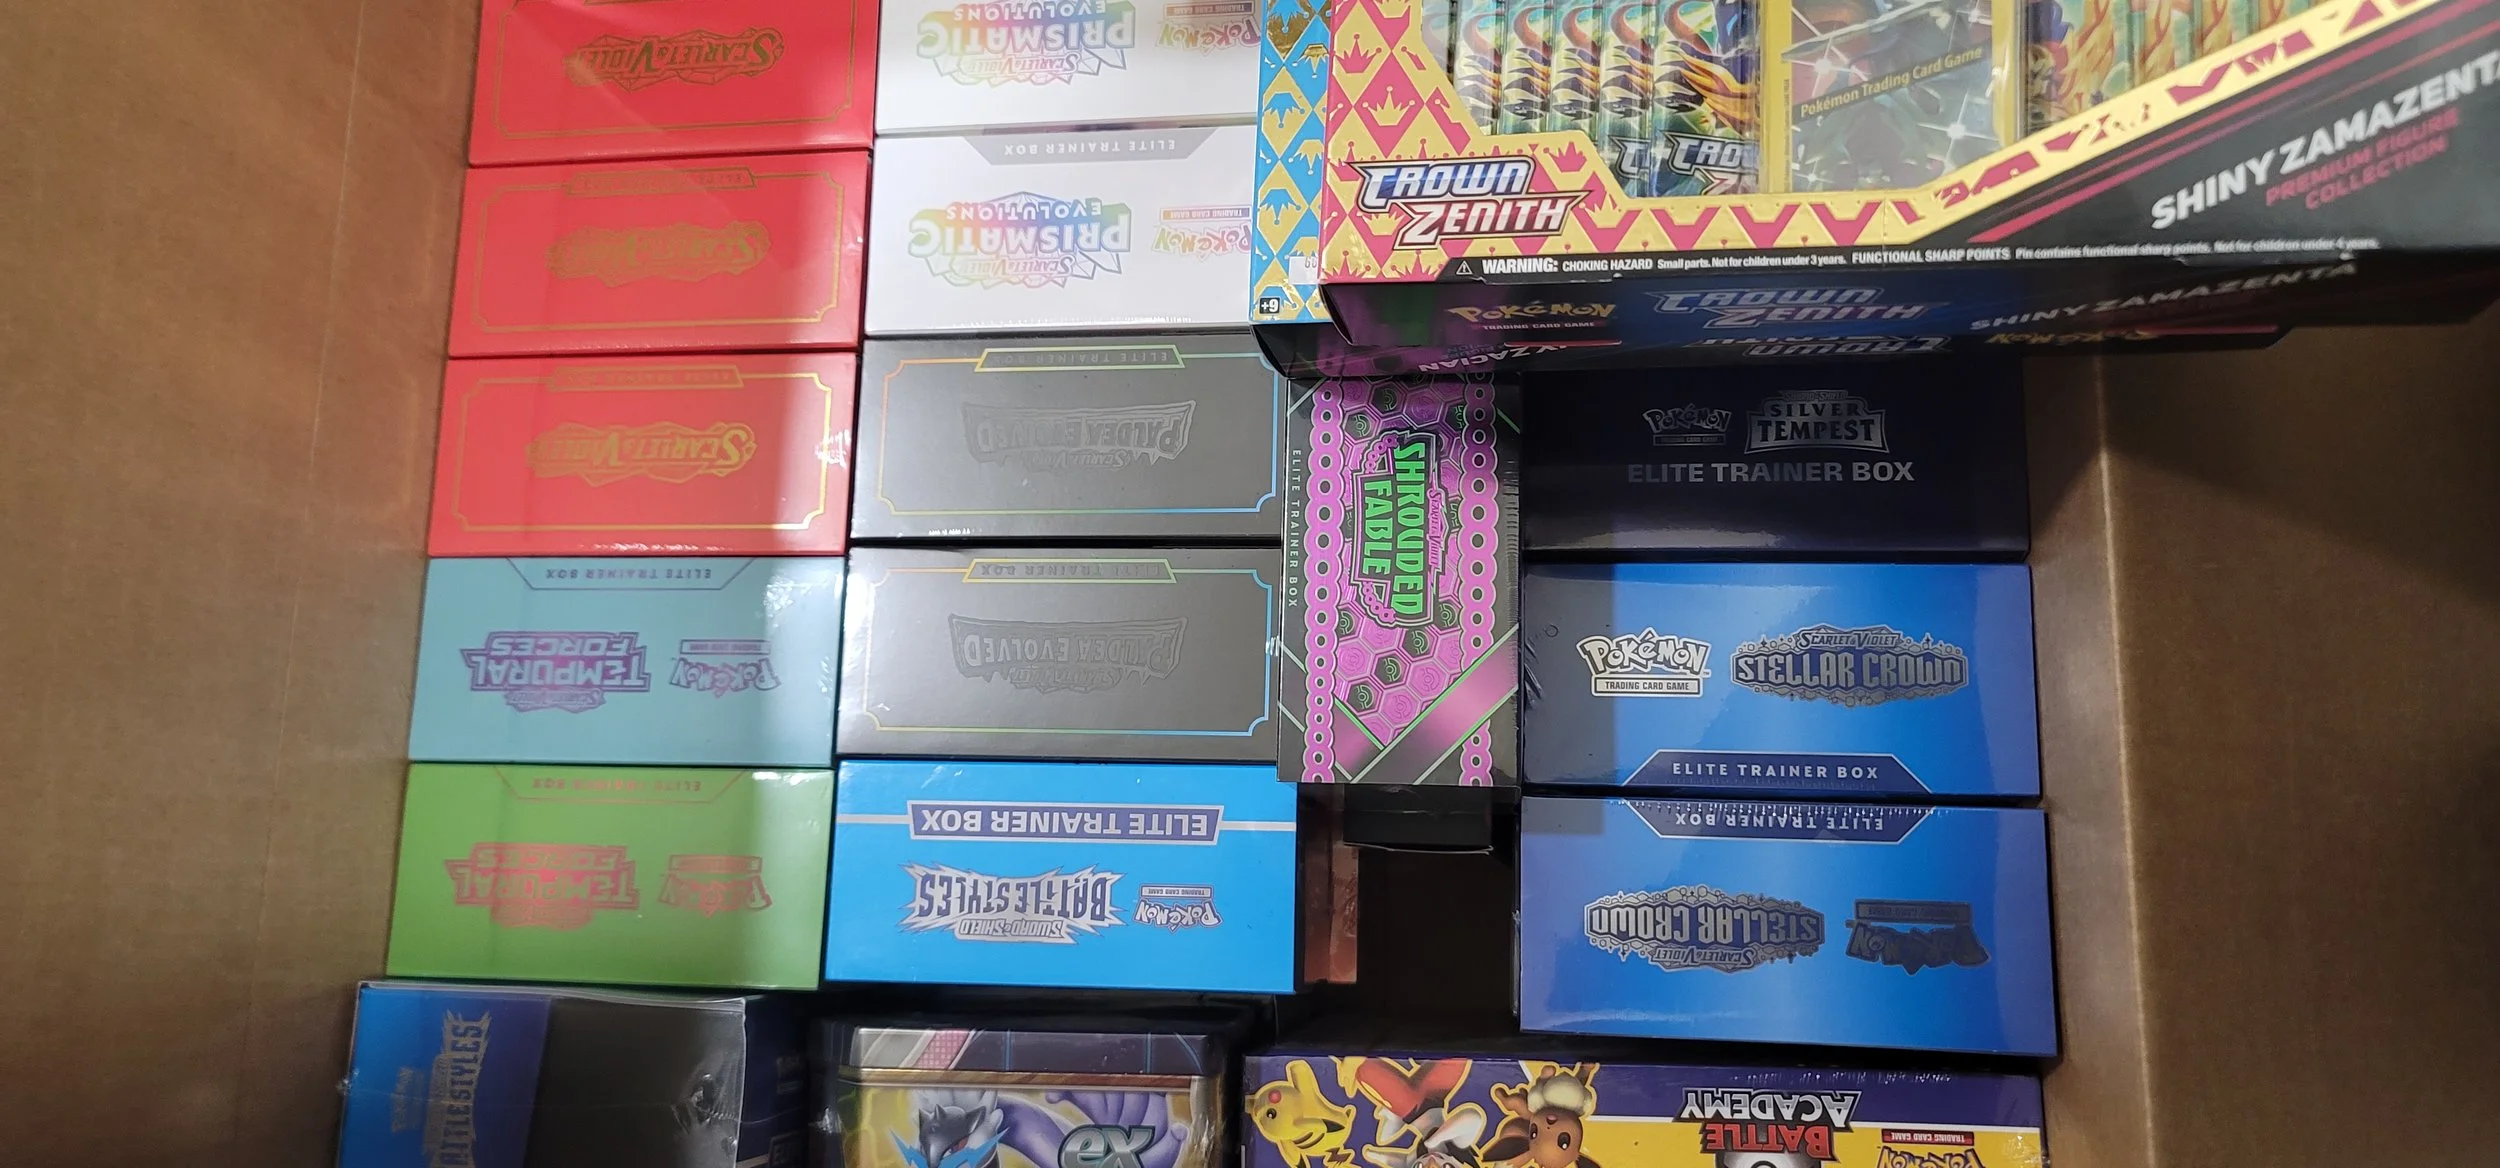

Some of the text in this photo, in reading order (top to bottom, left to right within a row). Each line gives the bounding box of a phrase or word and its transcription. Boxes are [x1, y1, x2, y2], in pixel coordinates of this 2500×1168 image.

[954, 0, 1106, 21] EVOLUTIONS
[916, 8, 1135, 59] PRISMATIC
[579, 42, 658, 73] VIOLE
[1801, 47, 1982, 118] Pokémon Trading Card Game
[1004, 140, 1175, 156] ELITE TRAINER BOX
[2266, 108, 2458, 206] PREMIUM FIGURE
[2305, 134, 2448, 209] COLLECTION
[1362, 160, 1532, 209] CROWN
[2152, 149, 2275, 229] SHINY
[946, 198, 1102, 221] EVOLUTIONS
[1214, 209, 1242, 218] TRADING
[1400, 199, 1569, 244] ZENITH
[908, 203, 1131, 258] PRISMATIC
[1482, 258, 1558, 274] WARNING:
[1562, 261, 1608, 272] CHOKING
[1610, 259, 1652, 270] HAZARD
[1658, 258, 1683, 269] Small
[1684, 258, 1711, 270] parts.
[1712, 257, 1728, 267] Not
[1728, 256, 1742, 267] for
[1743, 256, 1781, 267] children
[1782, 255, 1809, 265] under
[1810, 254, 1817, 266] 3
[1817, 255, 1847, 267] years.
[1852, 251, 1924, 264] FUNCTIONAL
[1925, 250, 1966, 262] SHARP
[1966, 247, 2011, 260] POINTS
[2016, 248, 2034, 260] Pin
[2034, 248, 2081, 259] contains
[2082, 245, 2138, 258] functional
[2139, 244, 2171, 256] sharp
[1261, 299, 1279, 312] +9
[1660, 287, 1877, 312] CROWN
[1970, 262, 2356, 331] SHINY ZAMAZENTA
[1446, 299, 1616, 322] Pokémon
[1711, 304, 1925, 328] ZENITH
[1037, 353, 1109, 364] TRAINER
[1120, 352, 1167, 362] ELITE
[1418, 348, 1530, 372] ZACIAN
[1771, 402, 1861, 416] SILVER
[1757, 420, 1876, 441] TEMPEST
[1625, 462, 1915, 482] ELITE TRAINER BOX
[1289, 450, 1301, 607] ELITE TRAINER BOX
[1363, 480, 1392, 575] FABLE
[1391, 442, 1425, 614] SHROUDED
[545, 569, 712, 579] ELITE TRAINER BOX
[981, 564, 1017, 576] BOX
[1024, 564, 1102, 576] TRAINER
[489, 638, 628, 657] FORCES
[963, 634, 1069, 667] EVOLVED
[1580, 629, 1709, 676] Pokémon
[1797, 632, 1898, 649] SCARLET VIOLET
[469, 656, 642, 687] TEMPORAL
[1738, 652, 1965, 688] STELLAR CROWN
[1604, 680, 1690, 692] TRADING CARD GAME
[1672, 762, 1879, 780] ELITE TRAINER BOX
[921, 809, 1208, 837] ELITE TRAINER BOX
[1674, 813, 1883, 830] ELITE TRAINER BOX
[918, 873, 1106, 922] BATTLE STYLES
[958, 920, 1004, 934] SHIELD
[1134, 898, 1218, 932] Pokémon
[1591, 904, 1817, 942] STELLAR CROWN
[1014, 920, 1061, 938] SWORD
[1654, 947, 1755, 967] SCARLET VIOLET
[1680, 1092, 1855, 1127] ACADEMY
[1059, 1126, 1155, 1168] ex
[1704, 1123, 1831, 1159] BATTLE
[1890, 1132, 1964, 1143] TRADING CARD GAME
